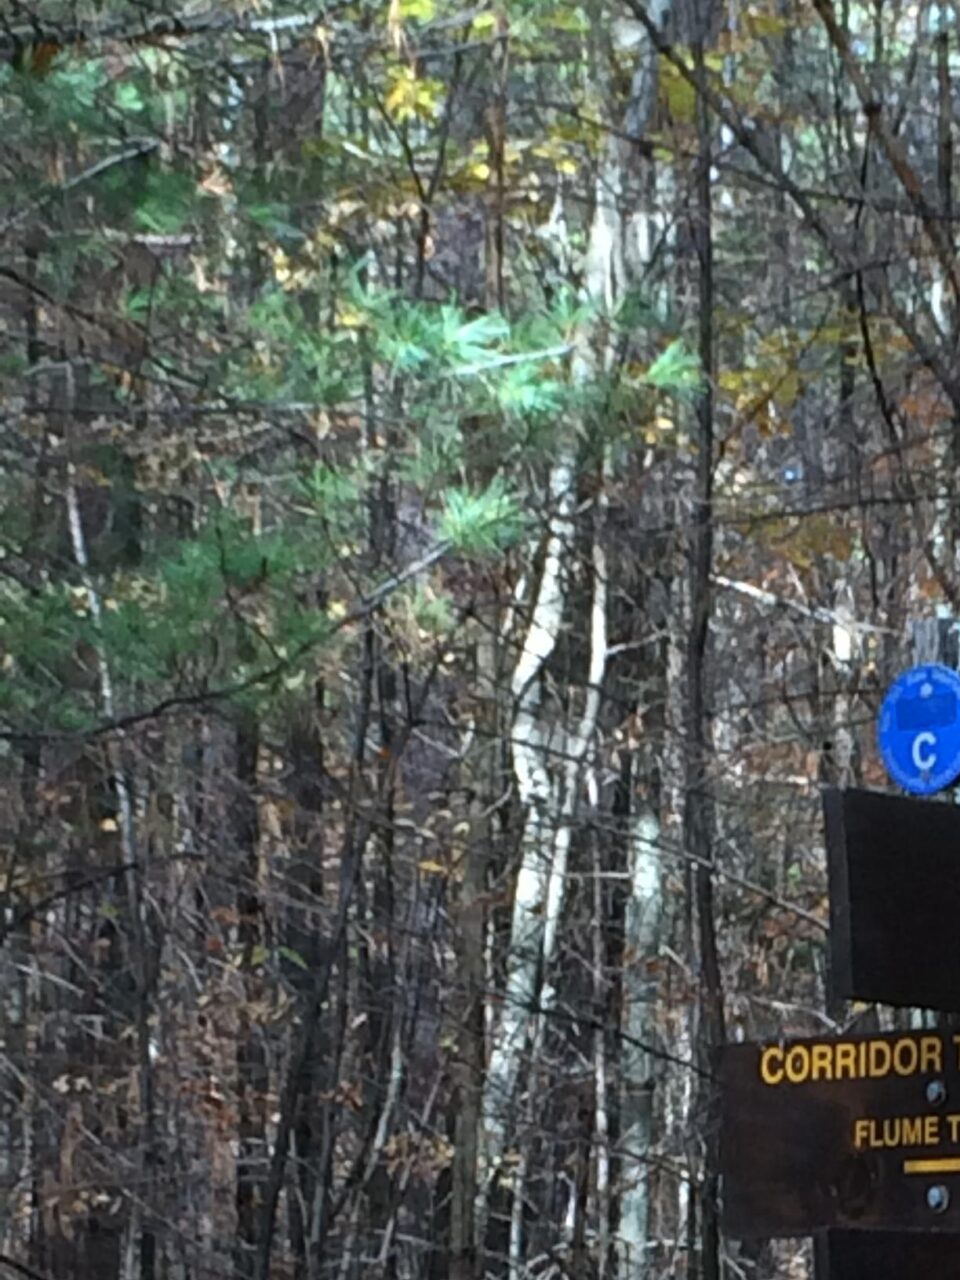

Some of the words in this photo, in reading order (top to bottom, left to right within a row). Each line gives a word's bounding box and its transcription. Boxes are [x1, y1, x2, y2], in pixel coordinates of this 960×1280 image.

[912, 732, 937, 770] C
[760, 1036, 942, 1085] CORRIDOR
[853, 1116, 940, 1148] FLUME
